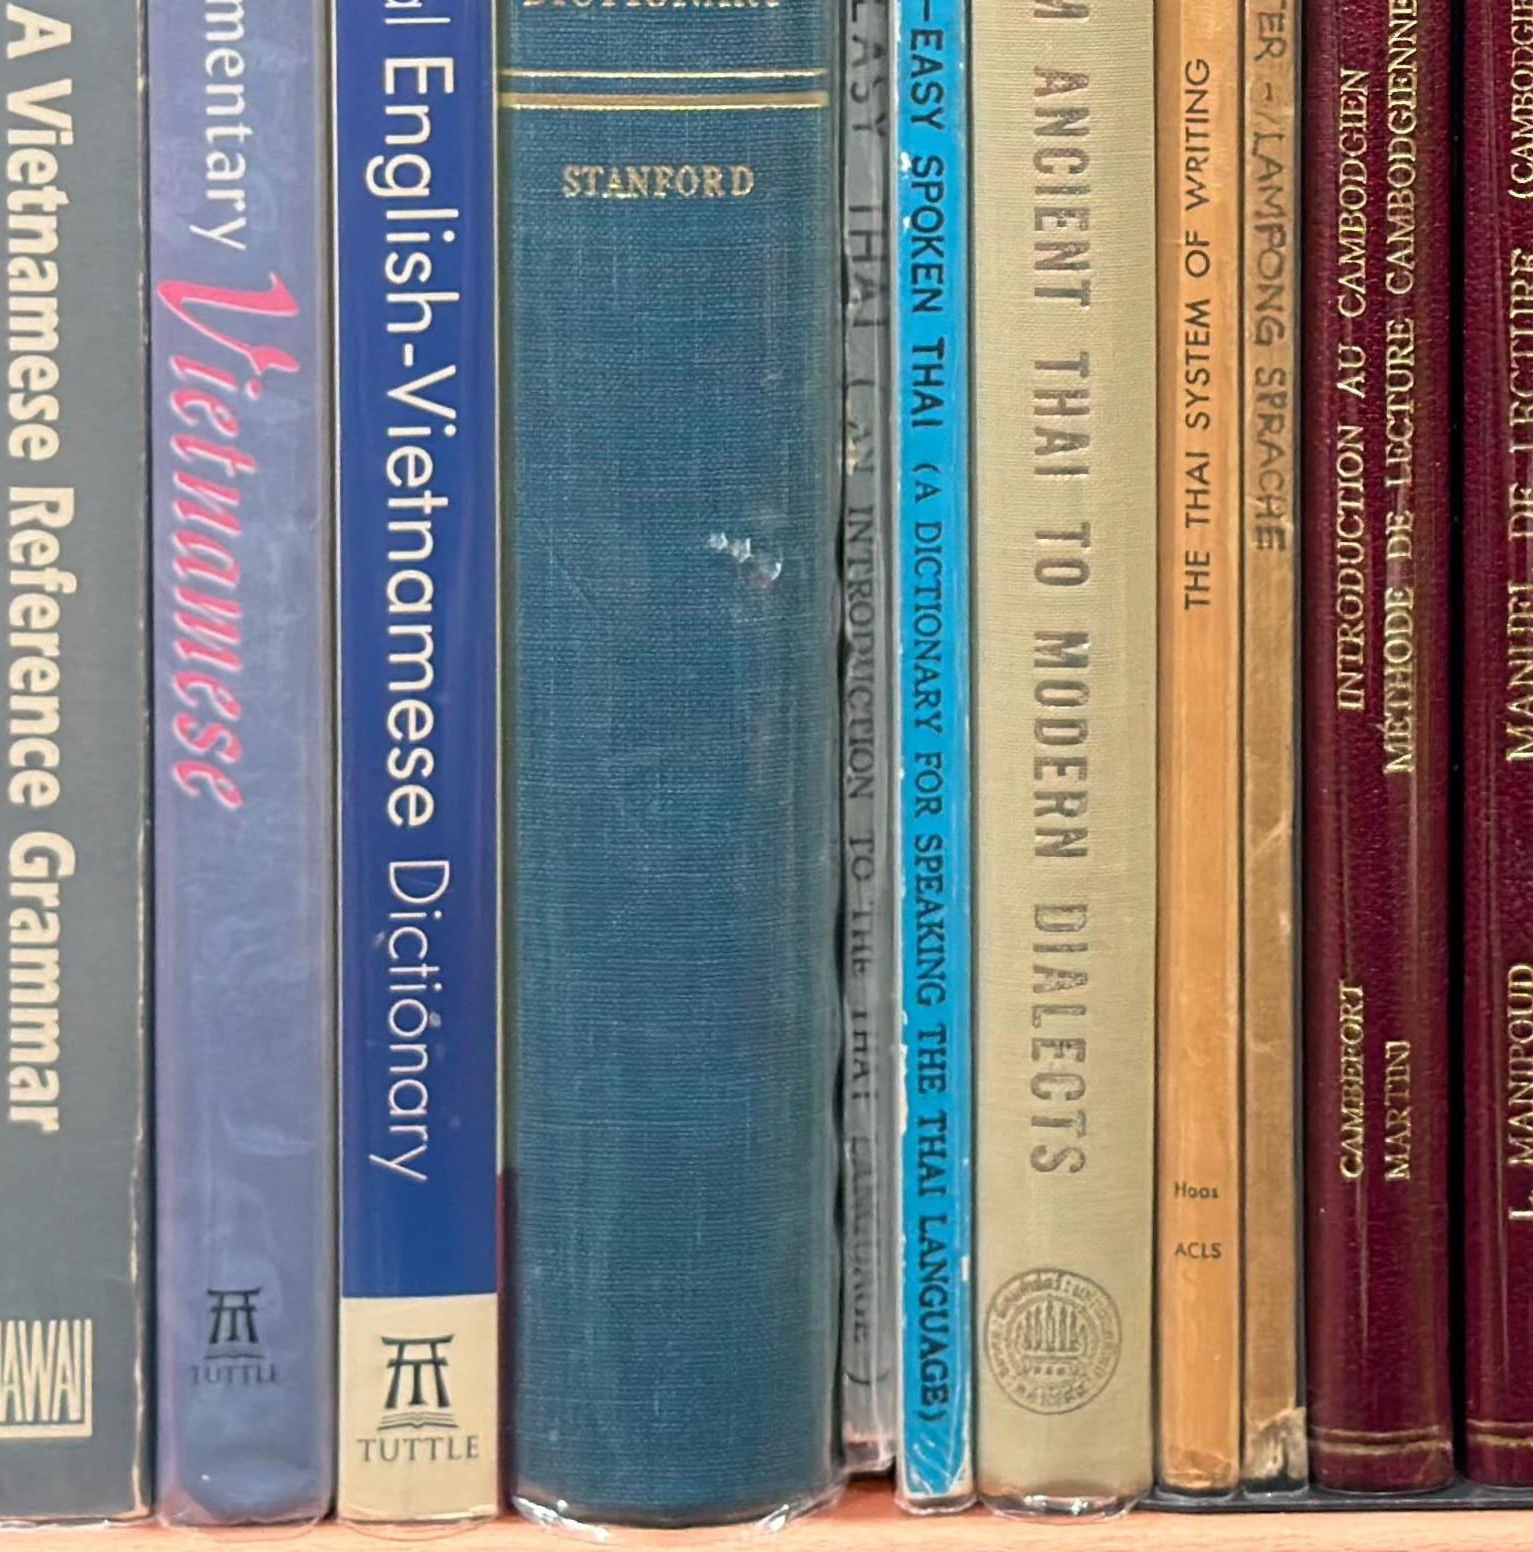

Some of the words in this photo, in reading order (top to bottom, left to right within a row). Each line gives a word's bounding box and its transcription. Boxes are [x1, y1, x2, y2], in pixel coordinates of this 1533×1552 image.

[6, 3, 73, 60] A
[561, 164, 756, 200] STANFORD
[1033, 64, 1091, 307] ANCIENT
[1184, 58, 1211, 211] WRITING
[1337, 68, 1370, 320] CAMBODGIEN
[6, 79, 74, 461] Vietnamese
[909, 154, 946, 313] SPOKEN
[1184, 230, 1211, 278] OF
[1252, 130, 1286, 347] LAMPONG
[909, 336, 946, 429] THAI
[1033, 350, 1091, 479] THAI
[1184, 299, 1211, 431] SYSTEM
[1336, 345, 1366, 400] AU
[1384, 318, 1415, 488] LECTURE
[366, 56, 460, 828] English-Vietnamese
[915, 463, 944, 504] (A
[1184, 450, 1211, 529] THAI
[1254, 366, 1286, 552] SPRACHE
[156, 270, 301, 810] Vietnamese
[1034, 520, 1092, 588] TO
[1184, 550, 1211, 611] THE
[1336, 423, 1366, 711] INTRODUCTION
[1385, 510, 1414, 561] DE
[7, 486, 78, 807] Reference
[914, 521, 944, 735] DICTIONARY
[916, 750, 943, 817] FOR
[1033, 631, 1092, 858] MODERN
[7, 831, 76, 1132] Grammar
[916, 833, 947, 1008] SPEAKING
[368, 858, 452, 1180] Dictionary
[918, 1022, 948, 1094] THE
[1030, 902, 1090, 1176] DIALECTS
[1339, 980, 1366, 1180] CAMBEFORT
[918, 1109, 948, 1196] THAI
[1174, 1181, 1220, 1200] Haas
[918, 1213, 950, 1425] LANGUAGE)
[1173, 1242, 1222, 1260] ACLS
[190, 1363, 281, 1387] TUTTLE
[356, 1434, 480, 1463] TUTTLE
